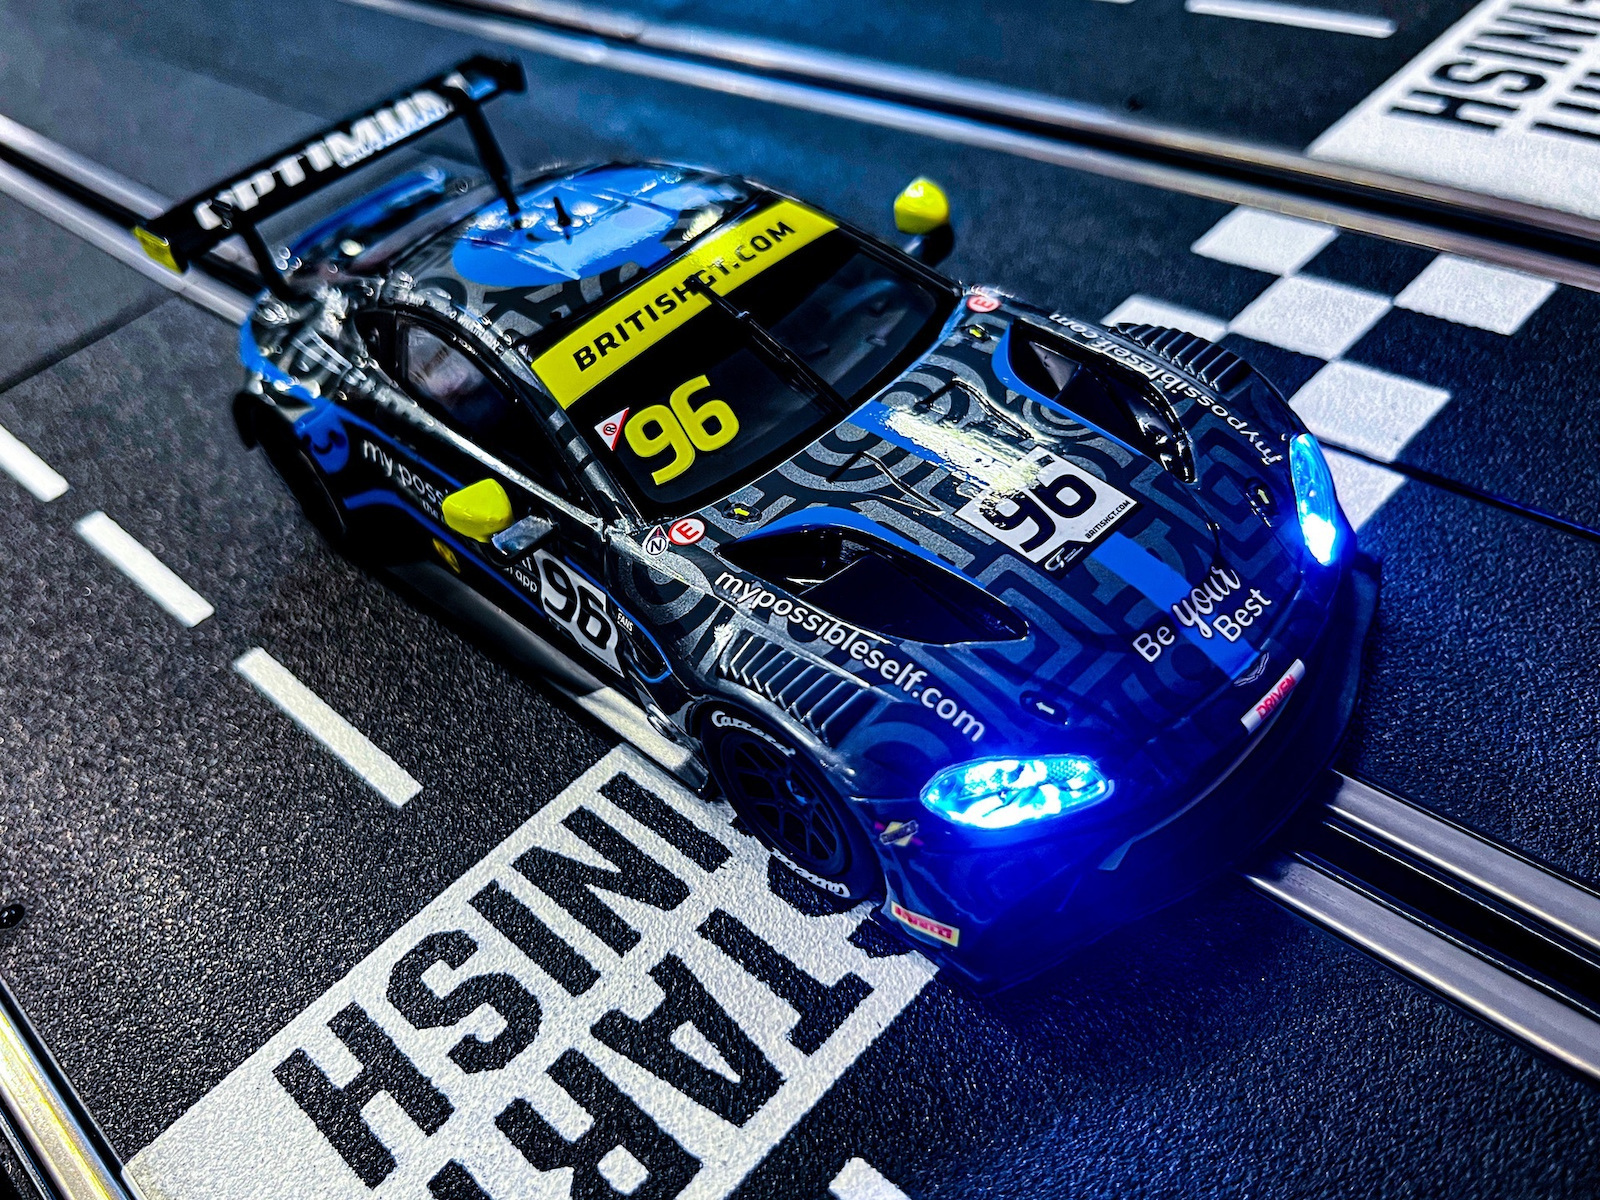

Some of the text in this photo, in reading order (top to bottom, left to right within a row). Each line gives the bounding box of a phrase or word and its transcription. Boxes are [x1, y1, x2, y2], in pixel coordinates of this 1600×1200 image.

[572, 220, 796, 372] BRITISHGT.COM
[624, 374, 740, 486] 96
[362, 439, 393, 477] my
[675, 521, 700, 540] E
[978, 473, 1098, 554] 96
[1084, 499, 1132, 540] BRITISHGT.COM
[514, 569, 538, 593] app
[541, 557, 612, 650] 96
[1171, 565, 1242, 639] your
[1212, 588, 1273, 643] Best
[713, 570, 986, 743] mypossibleself.com
[1132, 625, 1176, 663] Be
[1255, 673, 1297, 720] DRIVEN
[711, 709, 797, 758] Carrera
